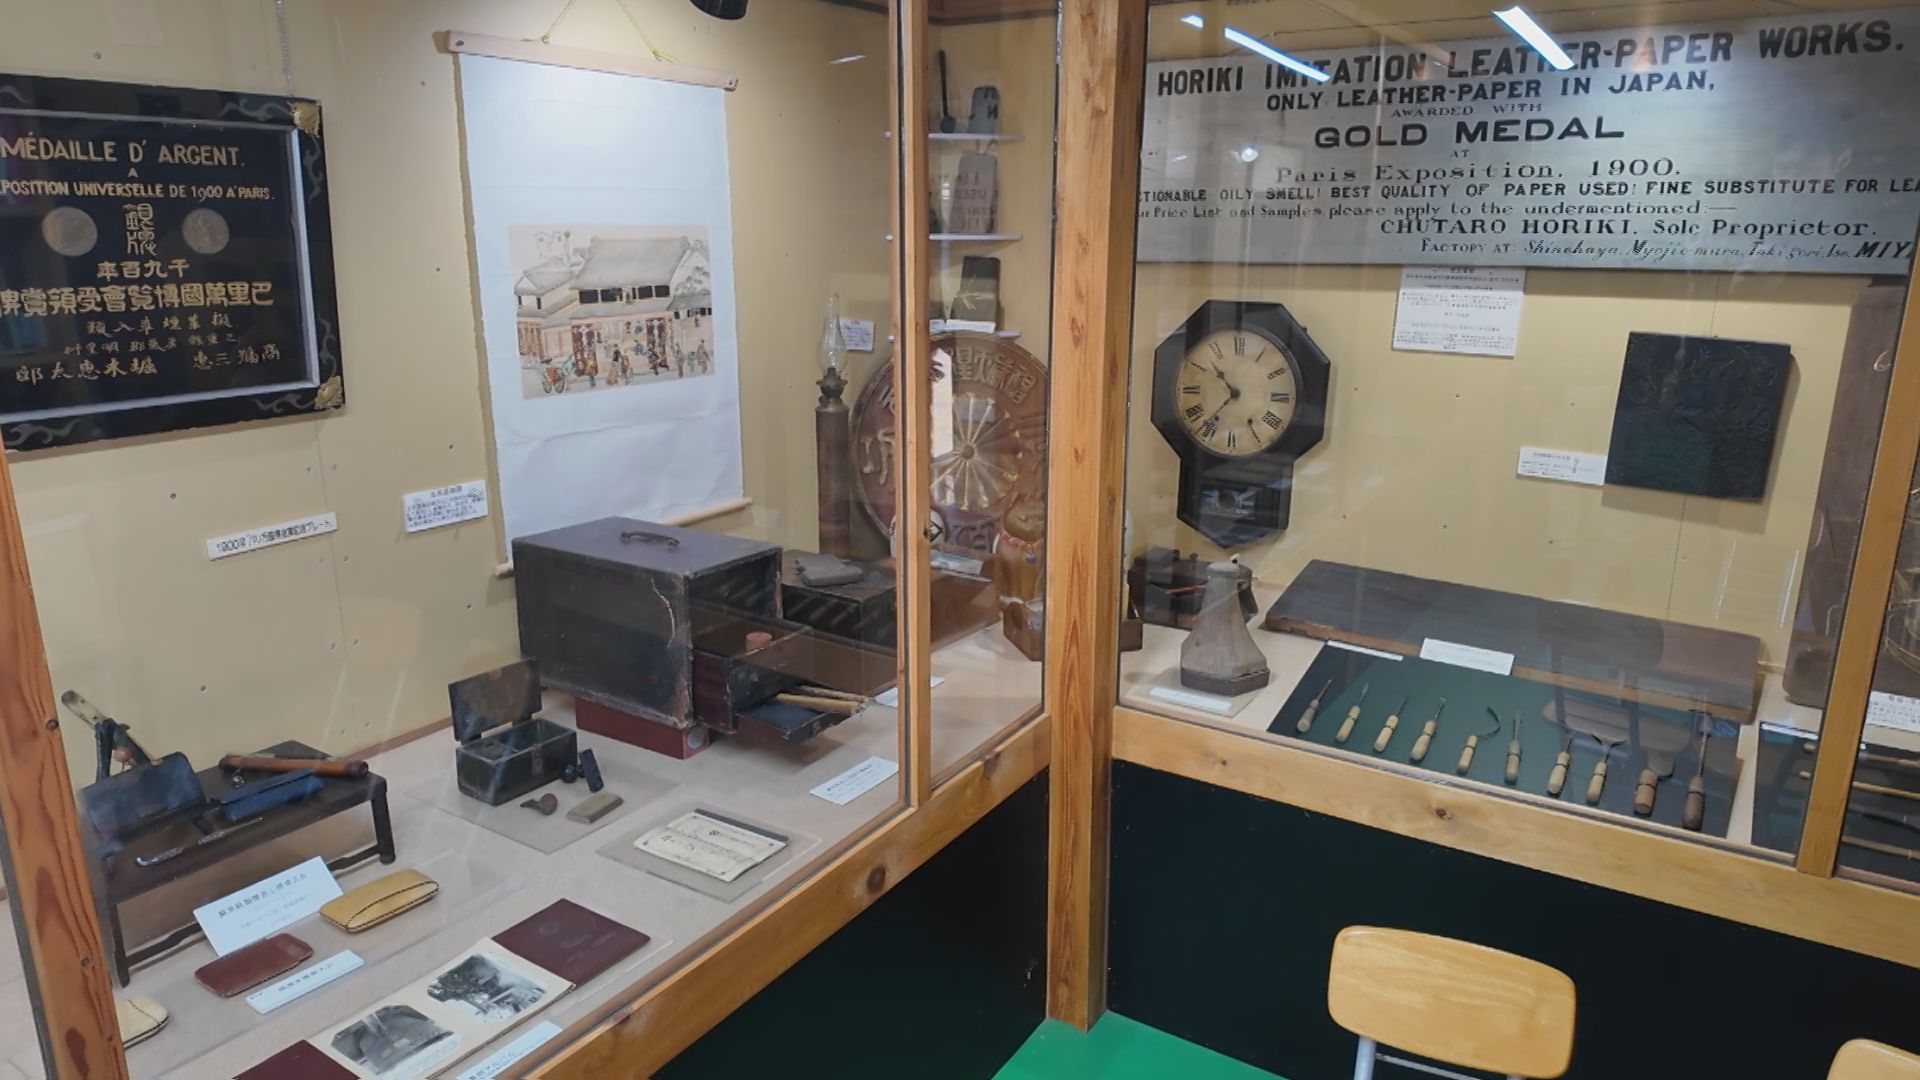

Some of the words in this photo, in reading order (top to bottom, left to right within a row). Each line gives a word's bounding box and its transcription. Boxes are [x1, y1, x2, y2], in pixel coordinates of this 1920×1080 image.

[1158, 66, 1243, 96] HORIKI
[1758, 20, 1904, 58] WORKS.
[1267, 91, 1323, 111] ONLY
[1337, 79, 1541, 108] LEATHER-PAPER
[1561, 77, 1591, 96] IN
[1608, 70, 1714, 94] JAPAN,
[1391, 105, 1474, 118] AWARDED
[1492, 103, 1542, 113] WITH
[1314, 124, 1428, 148] GOLD
[1455, 115, 1625, 144] MEDAL
[0, 131, 118, 162] MÉDAILLE
[158, 144, 245, 167] ARGENT.
[1451, 150, 1470, 158] AT
[1276, 167, 1356, 183] Paris
[73, 182, 164, 198] UNIVERSELLE
[169, 184, 187, 198] DE
[191, 185, 223, 203] 1900
[1140, 189, 1207, 202] TIONABLE
[1219, 189, 1253, 201] OILY
[1266, 187, 1320, 201] SMELL!
[1331, 185, 1371, 199] BEST
[1381, 184, 1451, 199] QUALITY
[1466, 183, 1490, 197] OF
[1504, 183, 1566, 196] PAPER
[1646, 181, 1692, 195] FINE
[1704, 179, 1835, 194] SUBSTITUTE
[1844, 179, 1878, 192] FOR
[1154, 206, 1189, 218] Price
[1193, 205, 1223, 218] List
[1329, 203, 1386, 220] please
[1394, 202, 1440, 222] apply
[1451, 202, 1471, 216] to
[1481, 201, 1513, 216] the
[1381, 218, 1506, 235] CHUTARO
[1653, 218, 1701, 235] Sole
